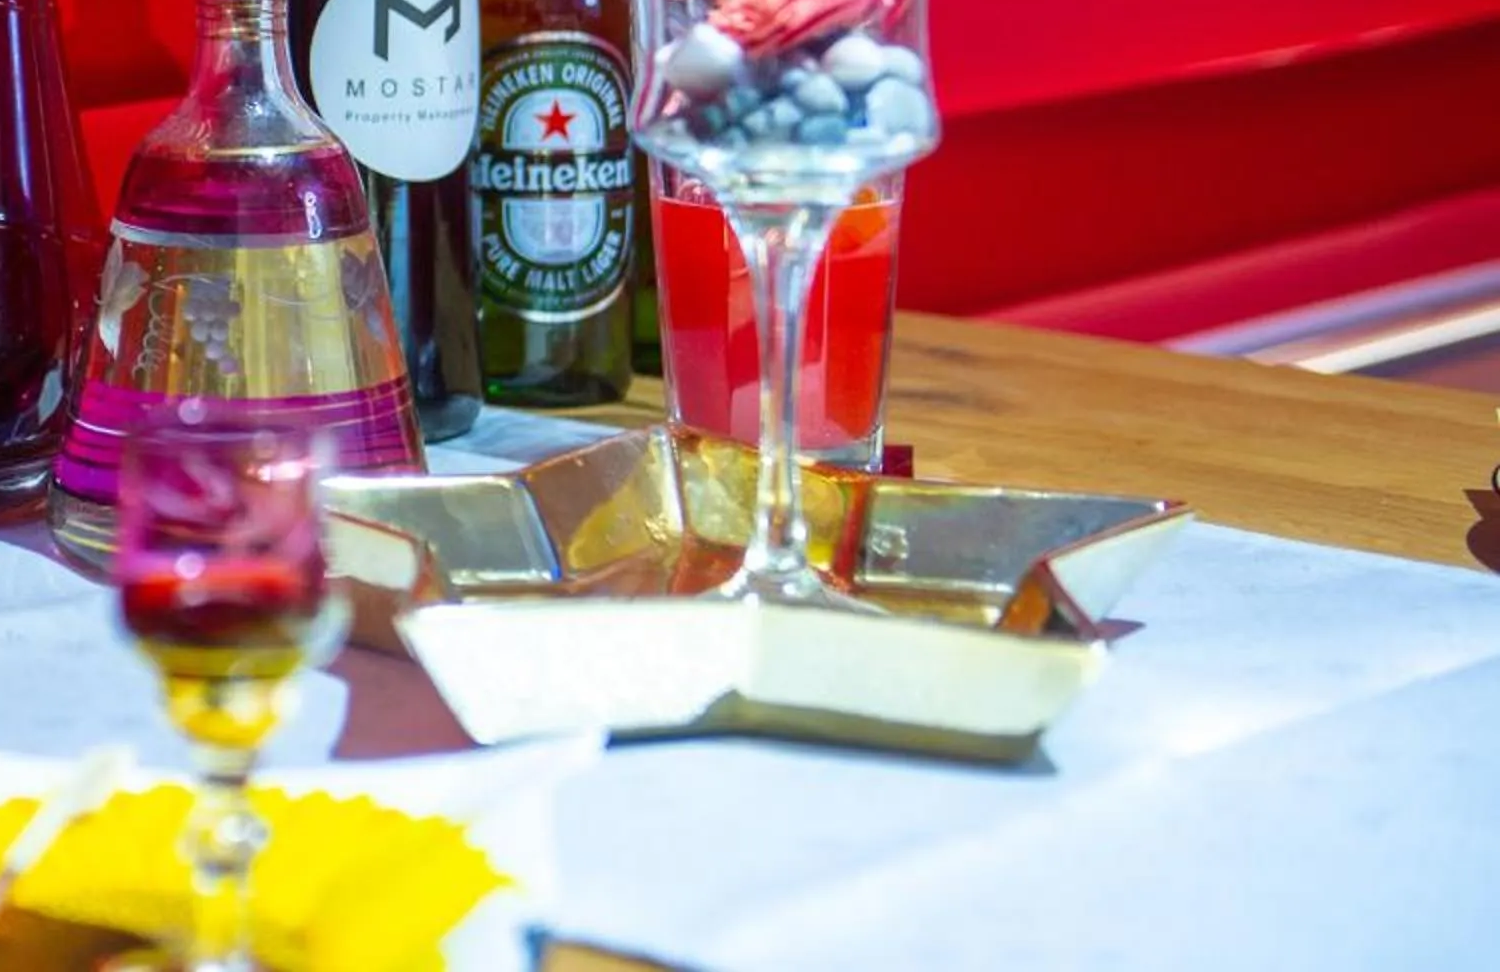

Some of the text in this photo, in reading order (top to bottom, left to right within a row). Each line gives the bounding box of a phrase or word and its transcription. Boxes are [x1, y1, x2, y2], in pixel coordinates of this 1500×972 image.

[482, 230, 622, 291] PURE MALT LAGER
